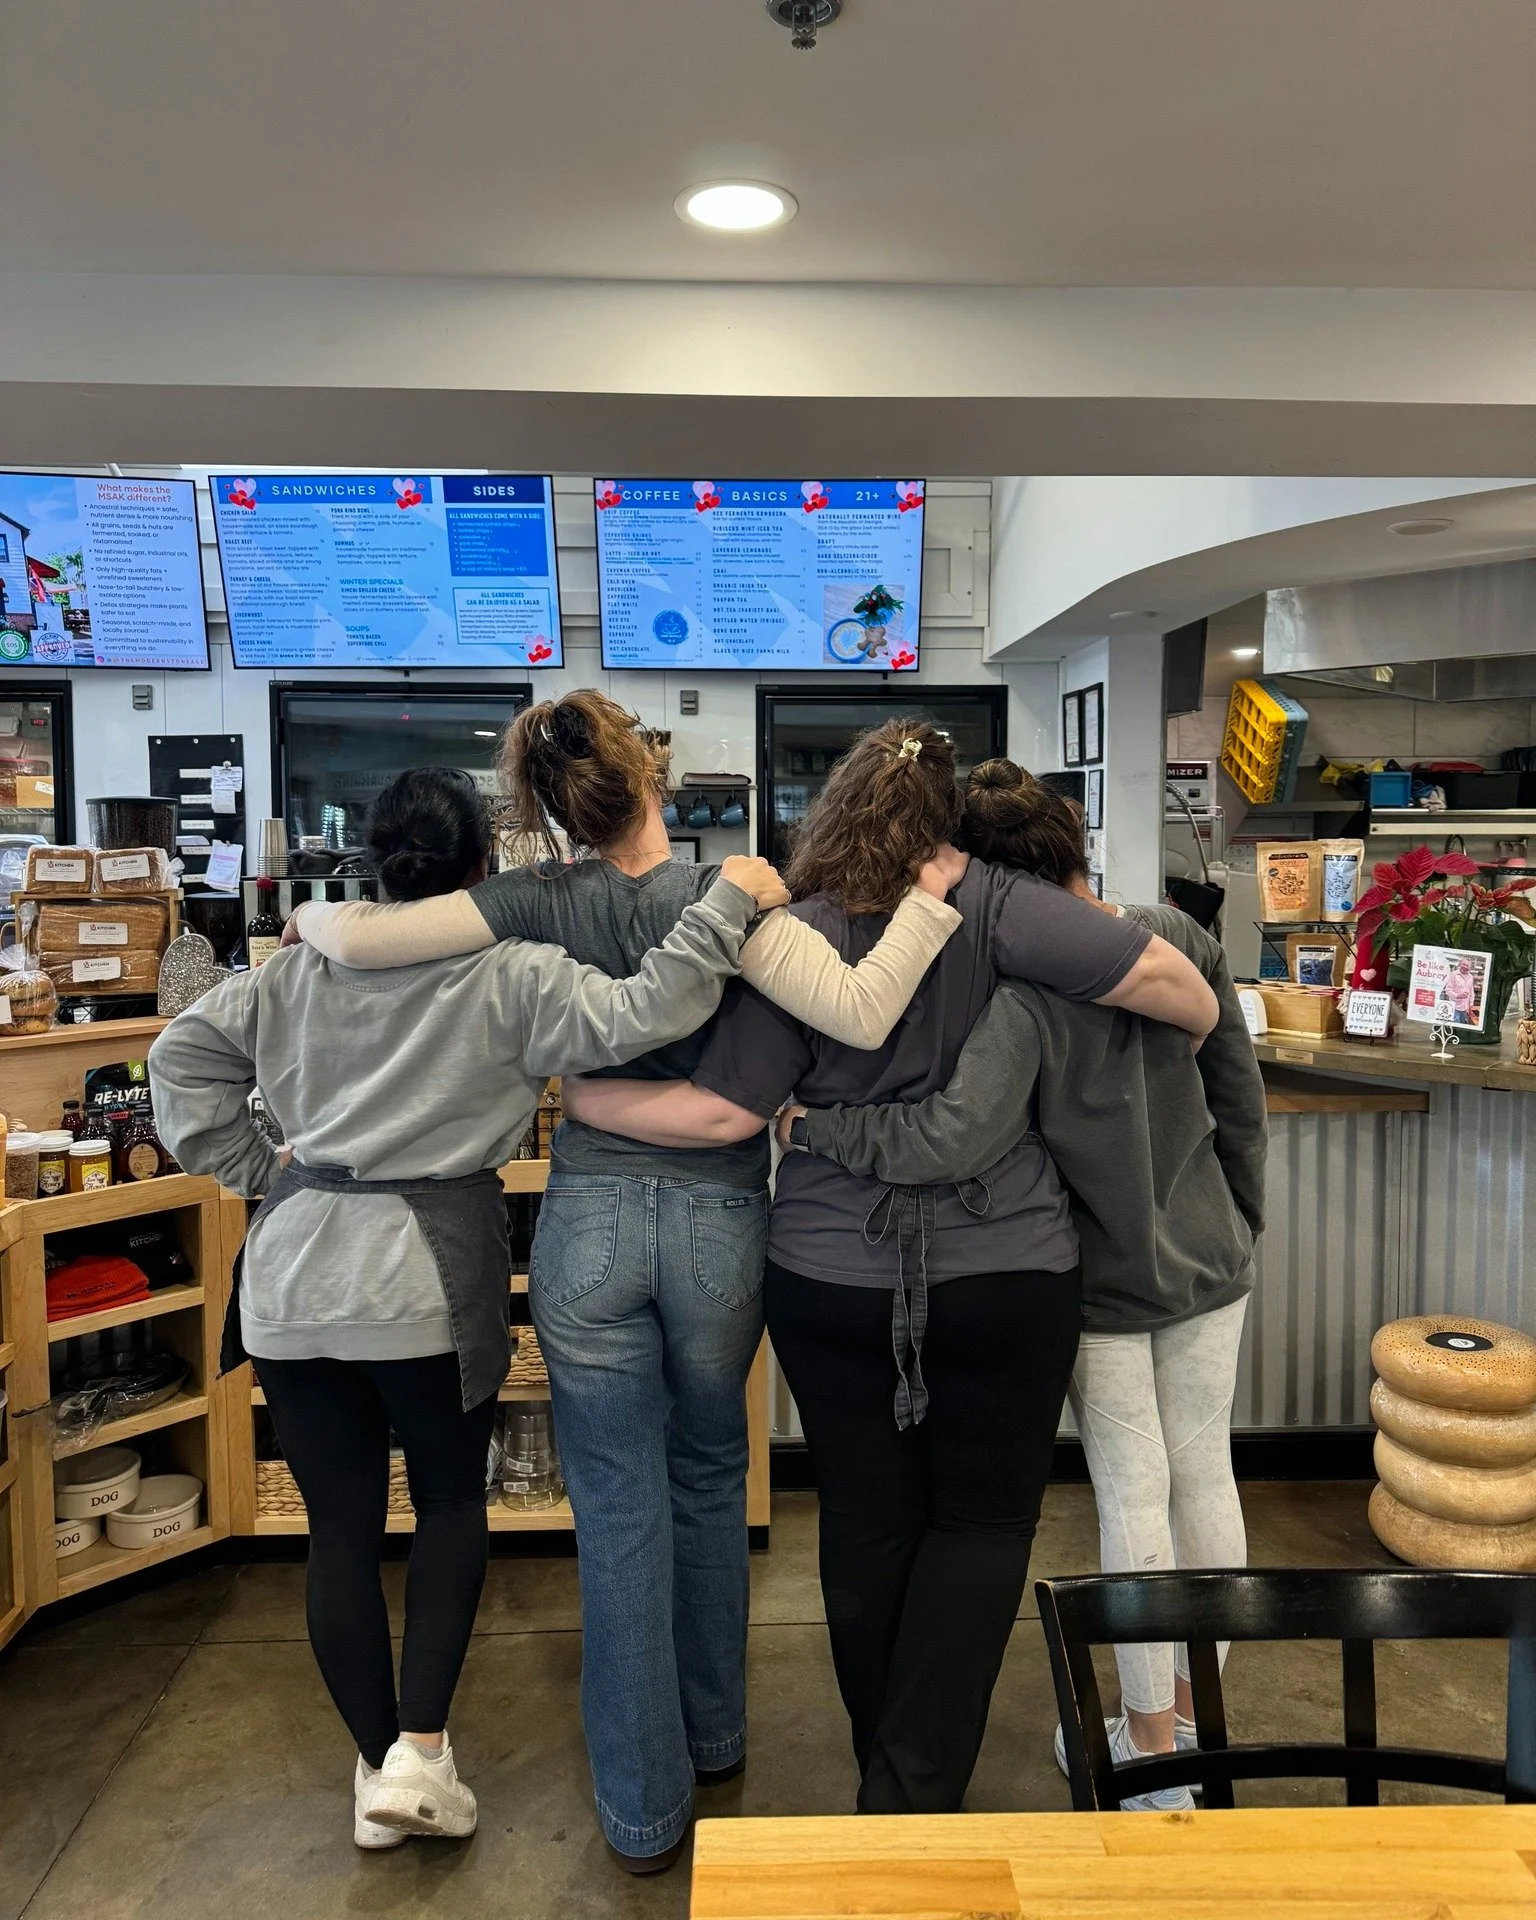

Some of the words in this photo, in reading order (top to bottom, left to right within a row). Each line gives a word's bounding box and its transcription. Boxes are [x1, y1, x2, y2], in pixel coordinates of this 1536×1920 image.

[272, 485, 377, 496] SANDWICHES
[473, 486, 515, 496] SIDES
[623, 491, 680, 500] COFFEE
[856, 491, 879, 501] 21+
[732, 492, 787, 501] BASICS
[36, 641, 70, 652] APPROVED
[1429, 962, 1444, 970] like
[1416, 969, 1447, 980] Aubrey
[1352, 1002, 1385, 1016] EVERYONE
[94, 1085, 149, 1105] RE-LYTE
[91, 1491, 118, 1507] DOG
[153, 1522, 180, 1538] DOG
